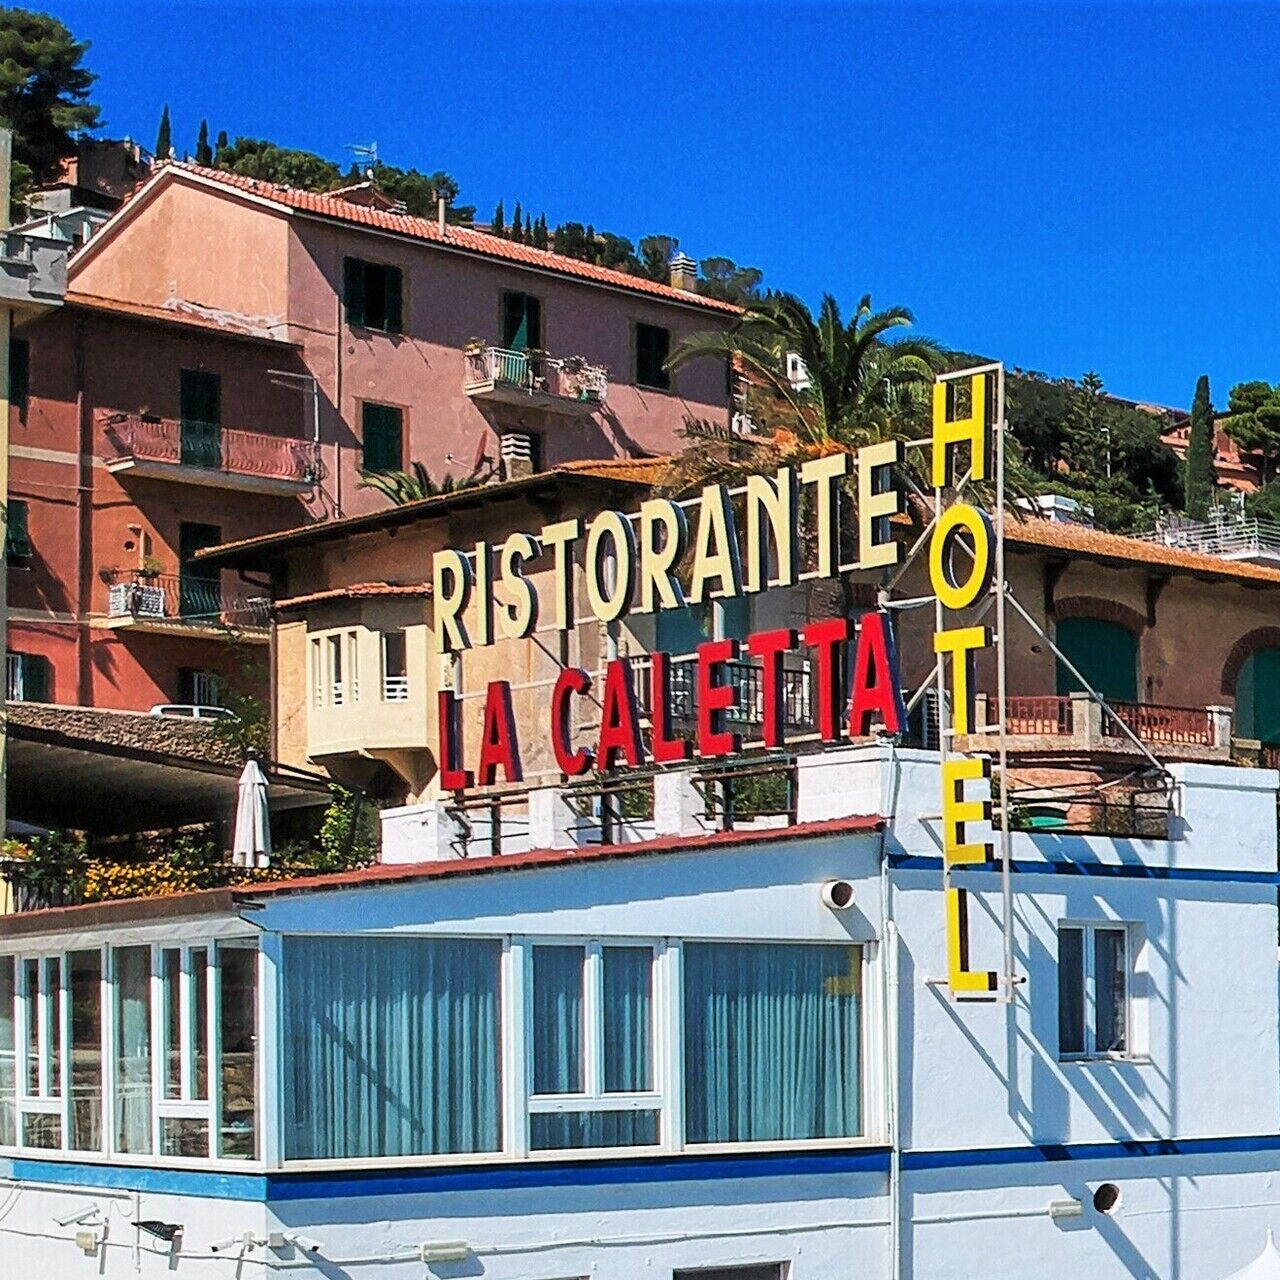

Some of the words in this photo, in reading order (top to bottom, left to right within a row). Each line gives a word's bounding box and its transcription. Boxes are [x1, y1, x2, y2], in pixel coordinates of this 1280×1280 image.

[432, 441, 899, 653] RISTORANTE
[438, 681, 522, 790] LA
[552, 613, 901, 775] CALETTA
[930, 374, 991, 992] HOTEL
